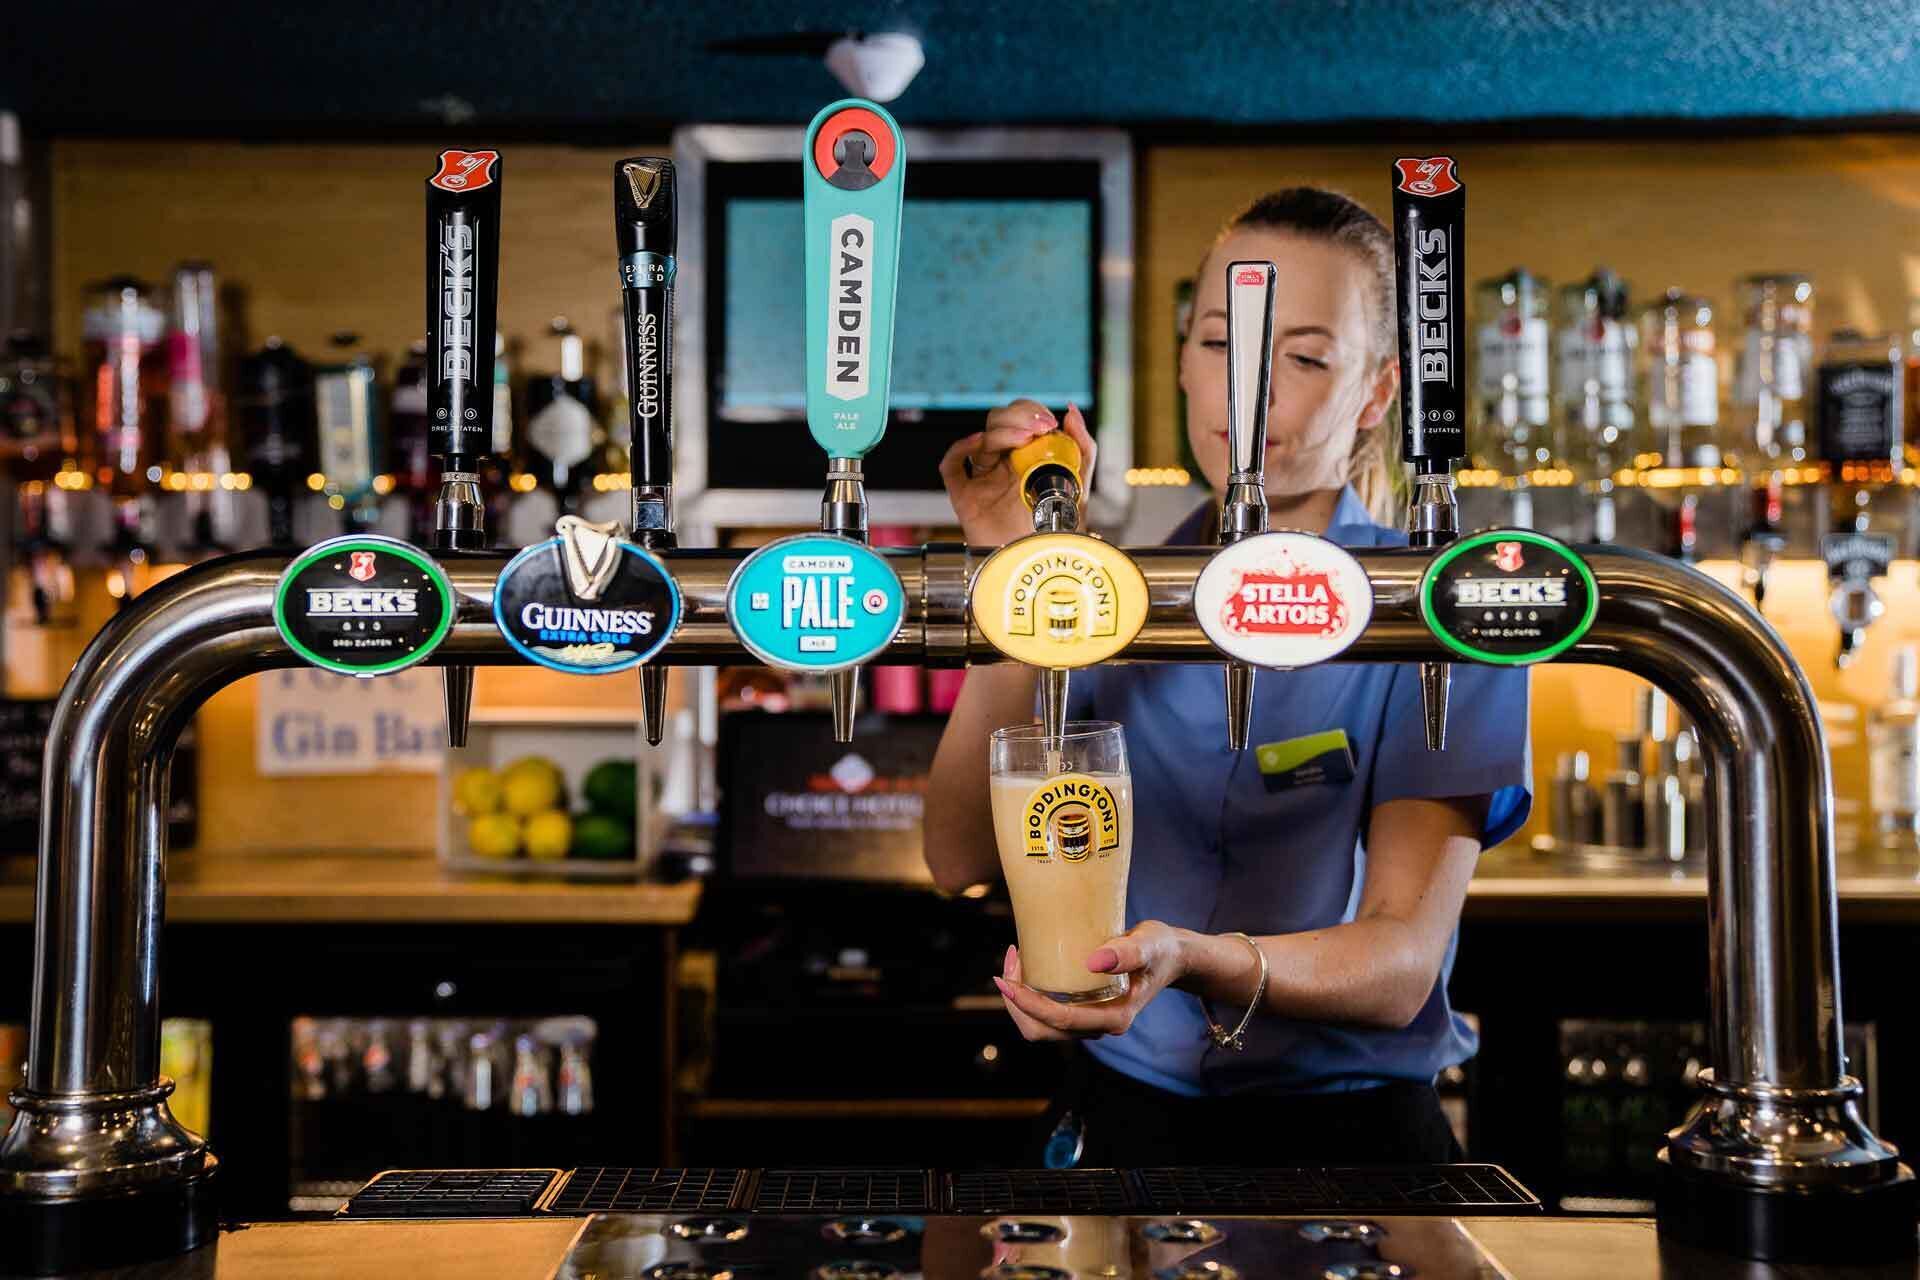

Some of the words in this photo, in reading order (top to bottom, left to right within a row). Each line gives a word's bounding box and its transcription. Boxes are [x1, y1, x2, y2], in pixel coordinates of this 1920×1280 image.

[625, 264, 665, 273] EXRA
[627, 273, 665, 282] CLD
[440, 224, 473, 381] BECK'S
[835, 227, 865, 383] CAMDEN
[1414, 228, 1449, 383] BECK'S
[637, 312, 659, 418] GUINNESS
[449, 425, 483, 433] ZATEN
[789, 560, 847, 569] CAMDEN
[1013, 556, 1111, 617] BODDINGTONS
[1241, 583, 1329, 603] STELLA
[1456, 579, 1565, 604] BECK'S
[308, 590, 417, 613] BECK'S
[781, 575, 856, 630] PALE
[1241, 604, 1330, 624] ARTOIS
[521, 602, 654, 635] GUINNESS
[539, 629, 588, 642] EXTRA
[591, 632, 632, 644] COLD
[1028, 783, 1114, 839] BODDINGTONS
